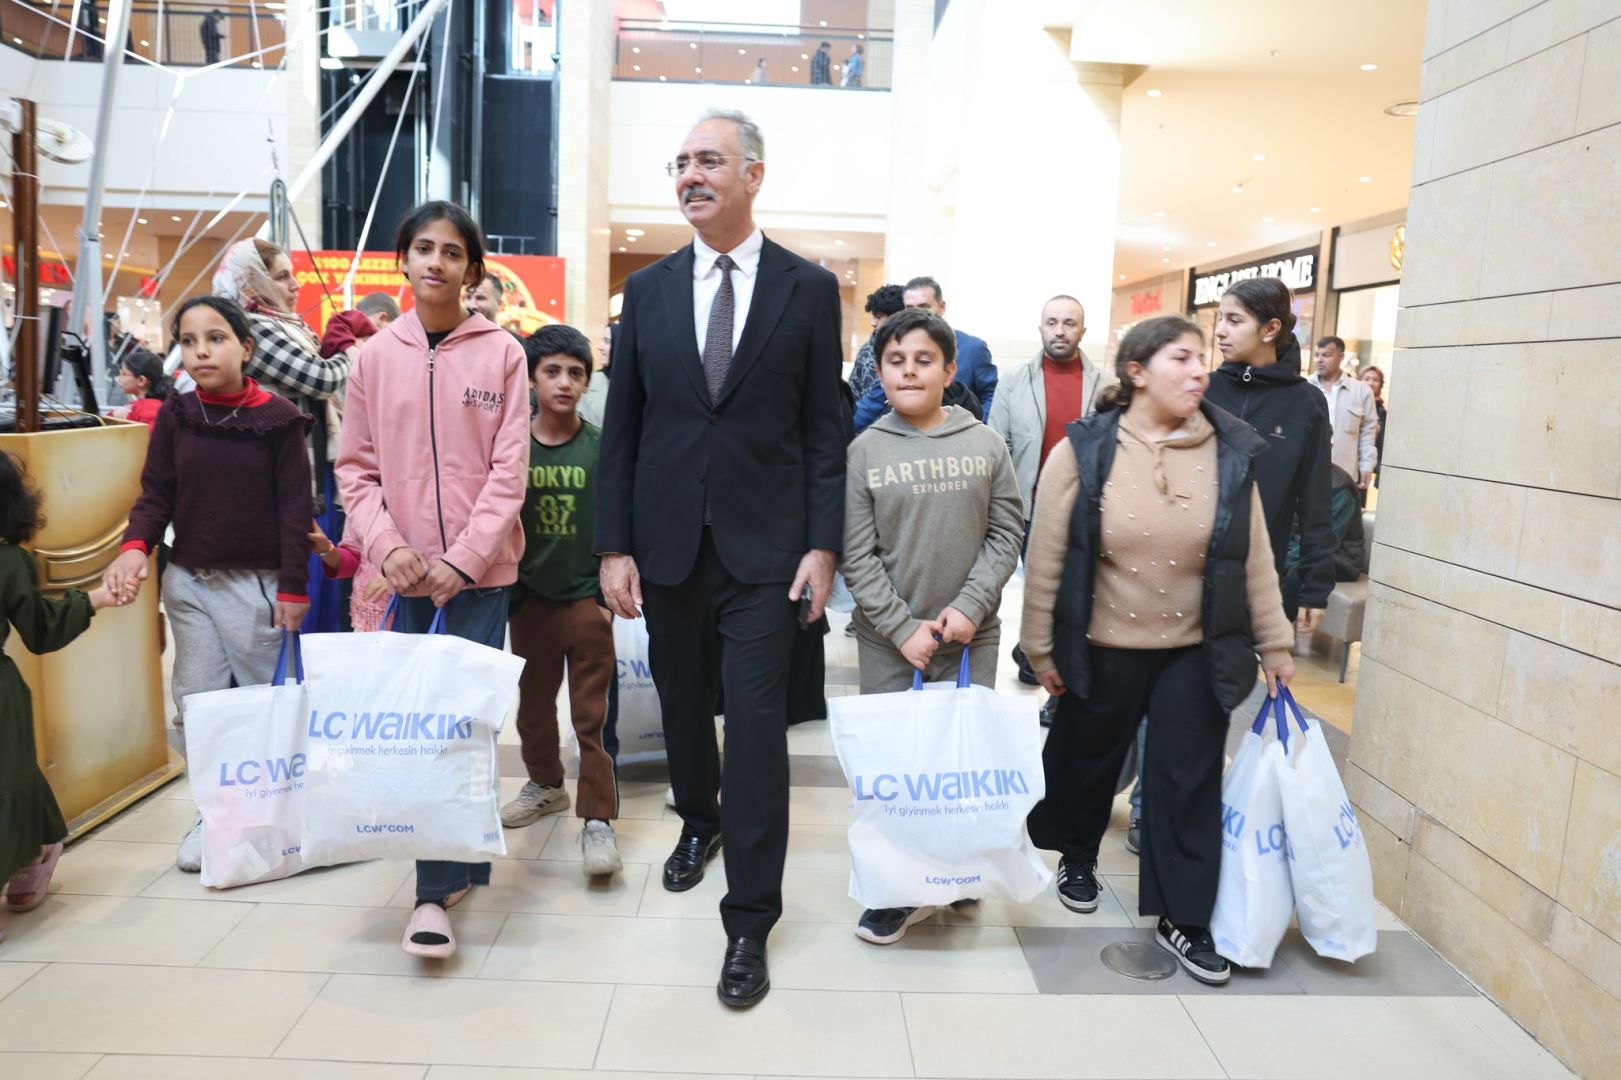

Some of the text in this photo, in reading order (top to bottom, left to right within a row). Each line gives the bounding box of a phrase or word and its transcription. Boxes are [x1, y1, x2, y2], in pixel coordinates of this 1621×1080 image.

[464, 387, 504, 404] ADIDAS
[913, 481, 968, 494] EXPLORER
[308, 710, 347, 740] LC
[219, 760, 261, 787] LC
[856, 774, 898, 801] LC
[885, 804, 896, 816] iyi
[899, 805, 942, 818] giyinmek
